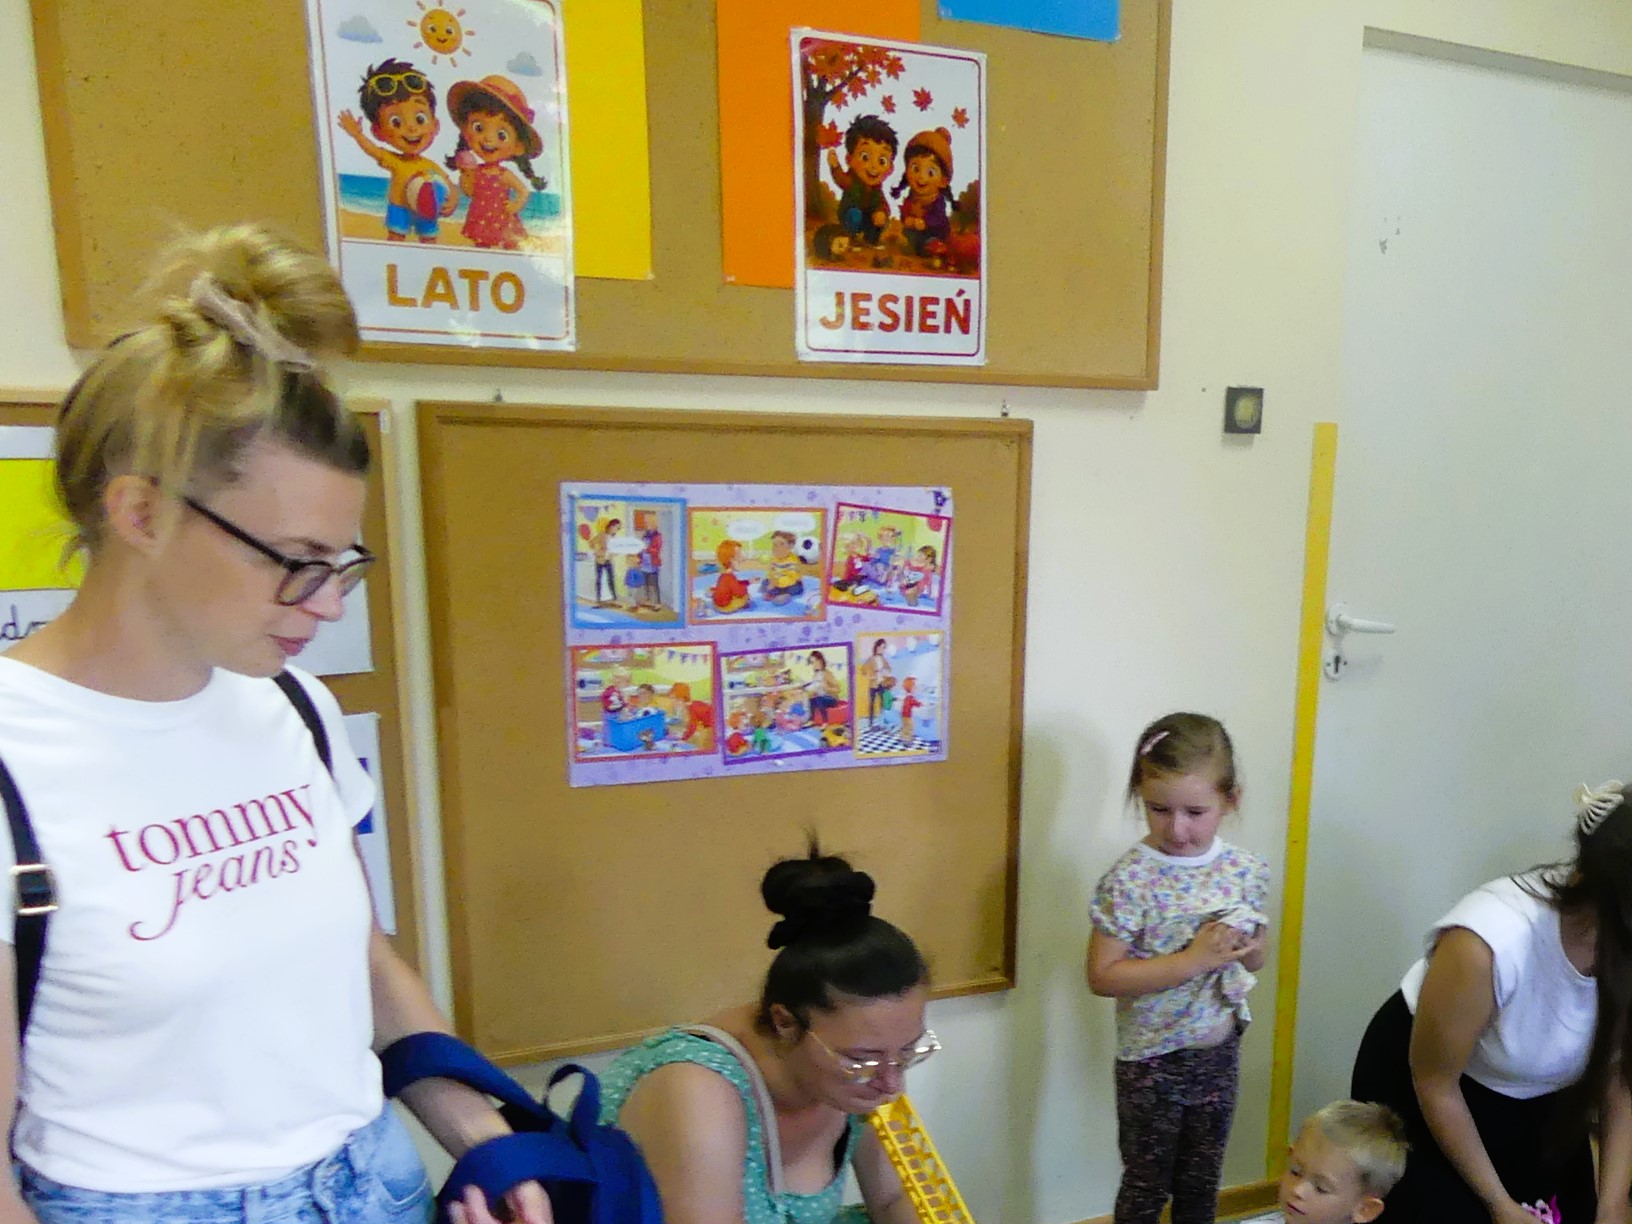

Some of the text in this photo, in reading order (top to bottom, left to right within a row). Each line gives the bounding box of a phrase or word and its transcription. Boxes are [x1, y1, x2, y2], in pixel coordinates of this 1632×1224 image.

[386, 263, 525, 314] LATO
[819, 288, 971, 335] JESIEŃ
[102, 784, 318, 873] tommy
